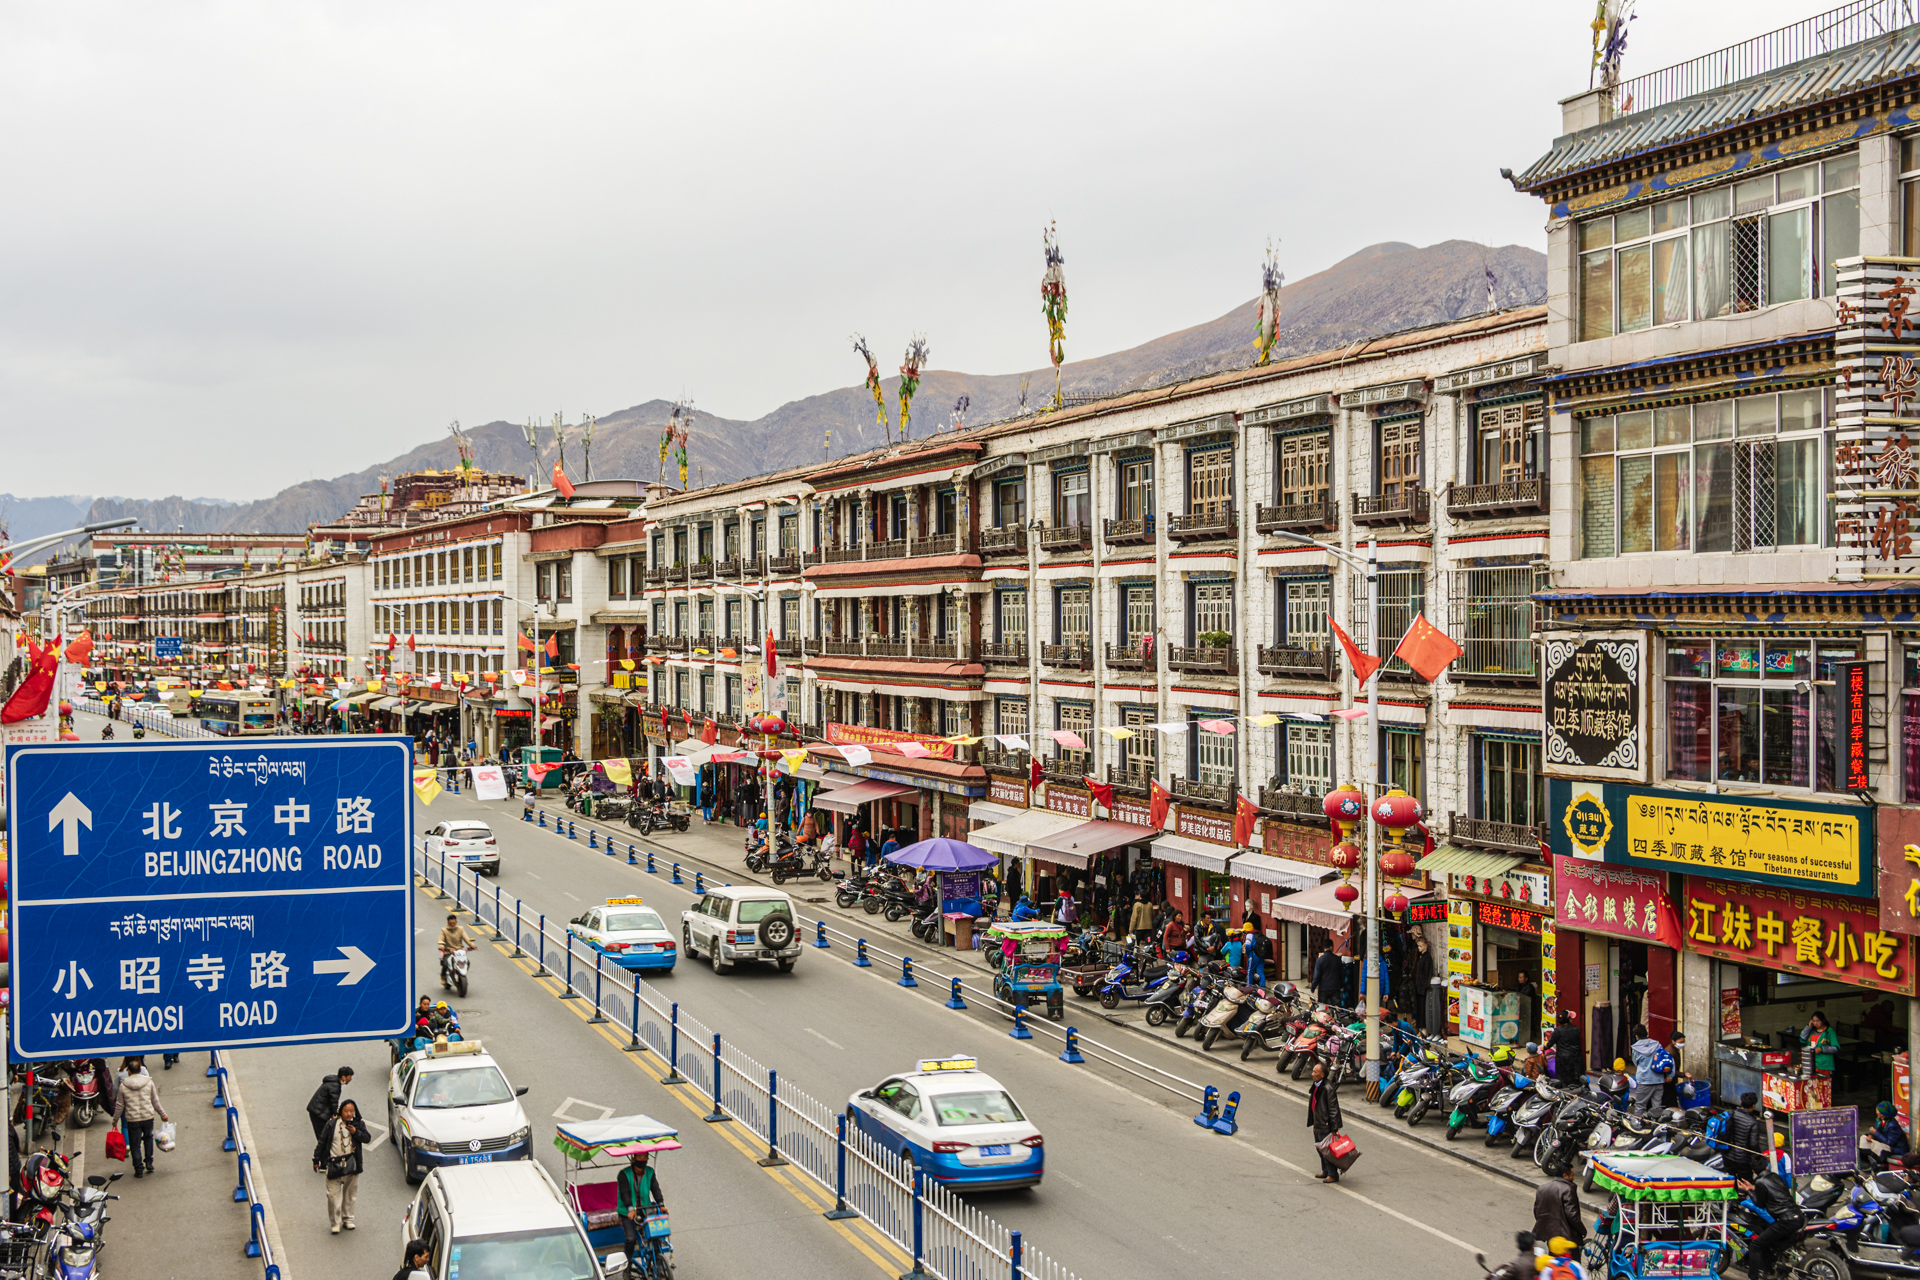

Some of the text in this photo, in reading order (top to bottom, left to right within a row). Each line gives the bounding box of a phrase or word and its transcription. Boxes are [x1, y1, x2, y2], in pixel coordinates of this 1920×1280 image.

[1554, 706, 1631, 741] 四季顺藏餐馆
[142, 796, 375, 840] 北京中路
[144, 844, 382, 877] BEIJINGZHONG ROAD
[1332, 848, 1347, 865] 勒
[1634, 838, 1746, 867] 四季顺藏餐馆
[1749, 849, 1852, 871] Four seasons of successful
[1763, 862, 1839, 881] Tibetan restaurants
[1564, 888, 1657, 934] 金彩服装店
[1689, 897, 1904, 980] 江妹中餐小吃
[52, 950, 290, 999] 小昭寺路
[51, 1000, 278, 1038] XIAOZHAOSI ROAD
[649, 1220, 670, 1231] 534
